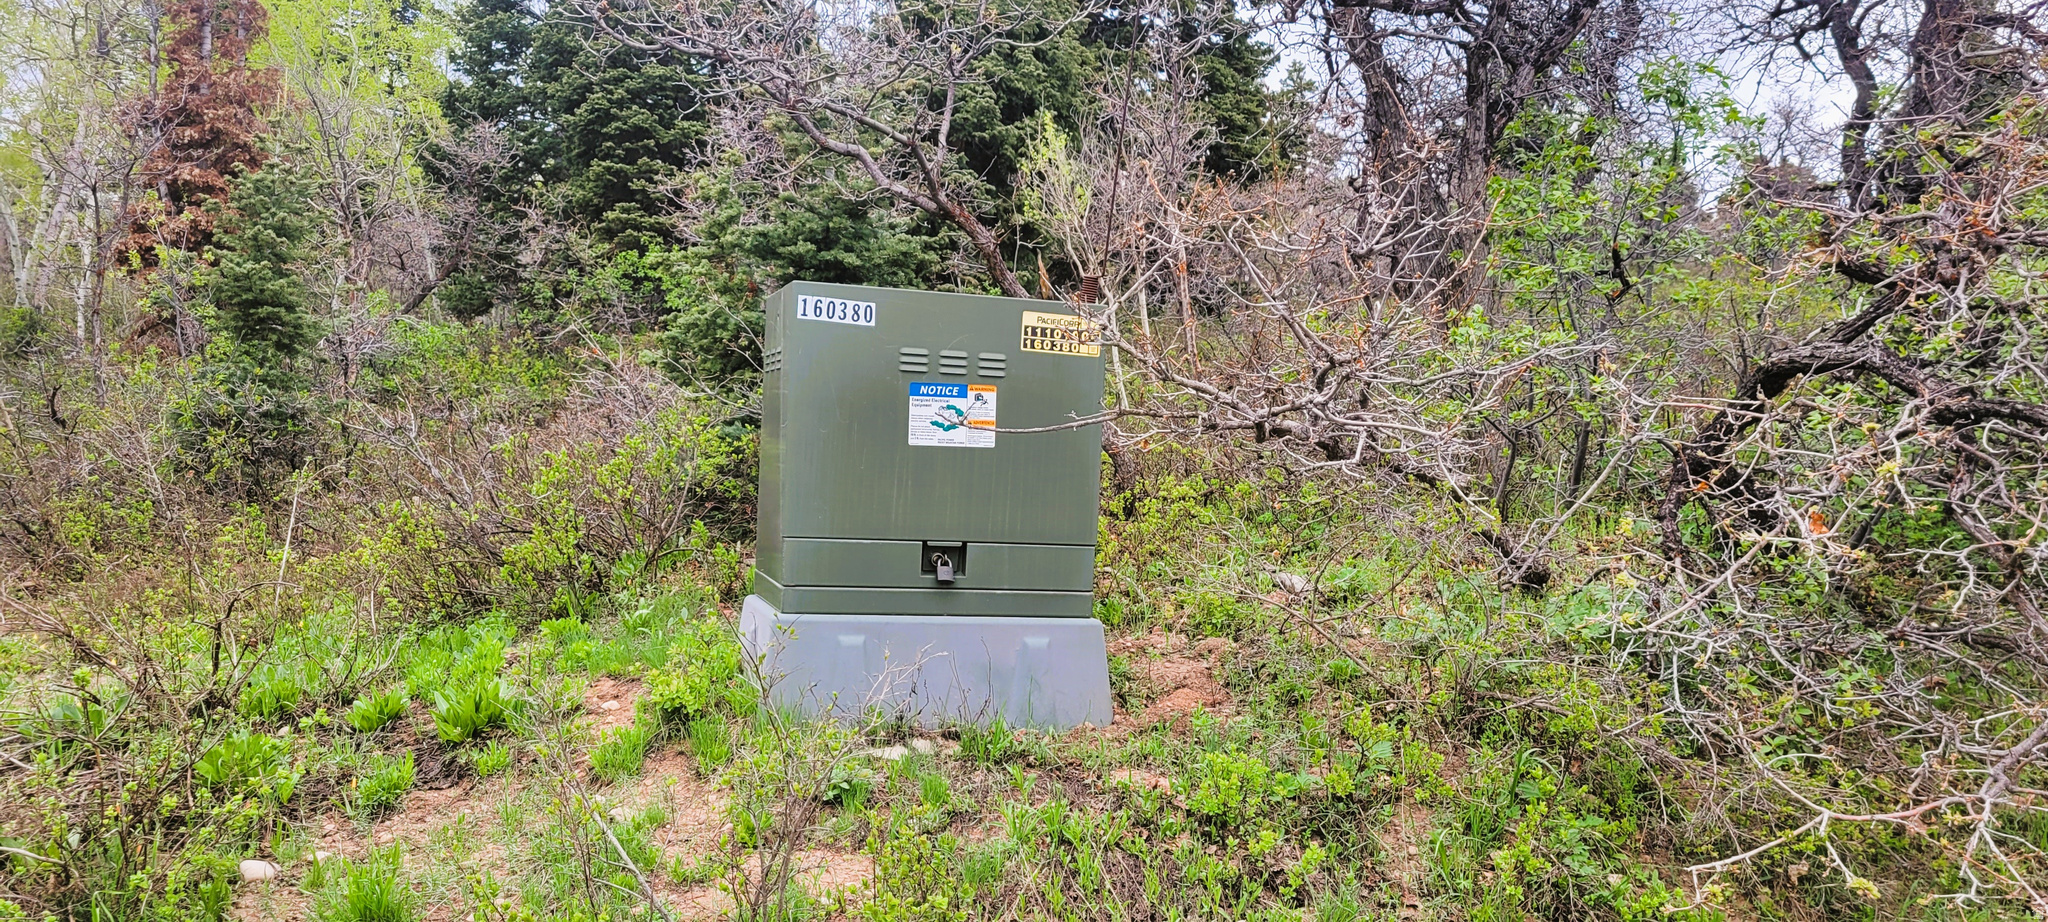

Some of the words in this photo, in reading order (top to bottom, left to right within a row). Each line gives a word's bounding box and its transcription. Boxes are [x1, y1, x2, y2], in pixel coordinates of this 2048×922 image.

[800, 298, 873, 323] 160380
[1025, 339, 1078, 353] 160380
[919, 385, 959, 396] NOTICE
